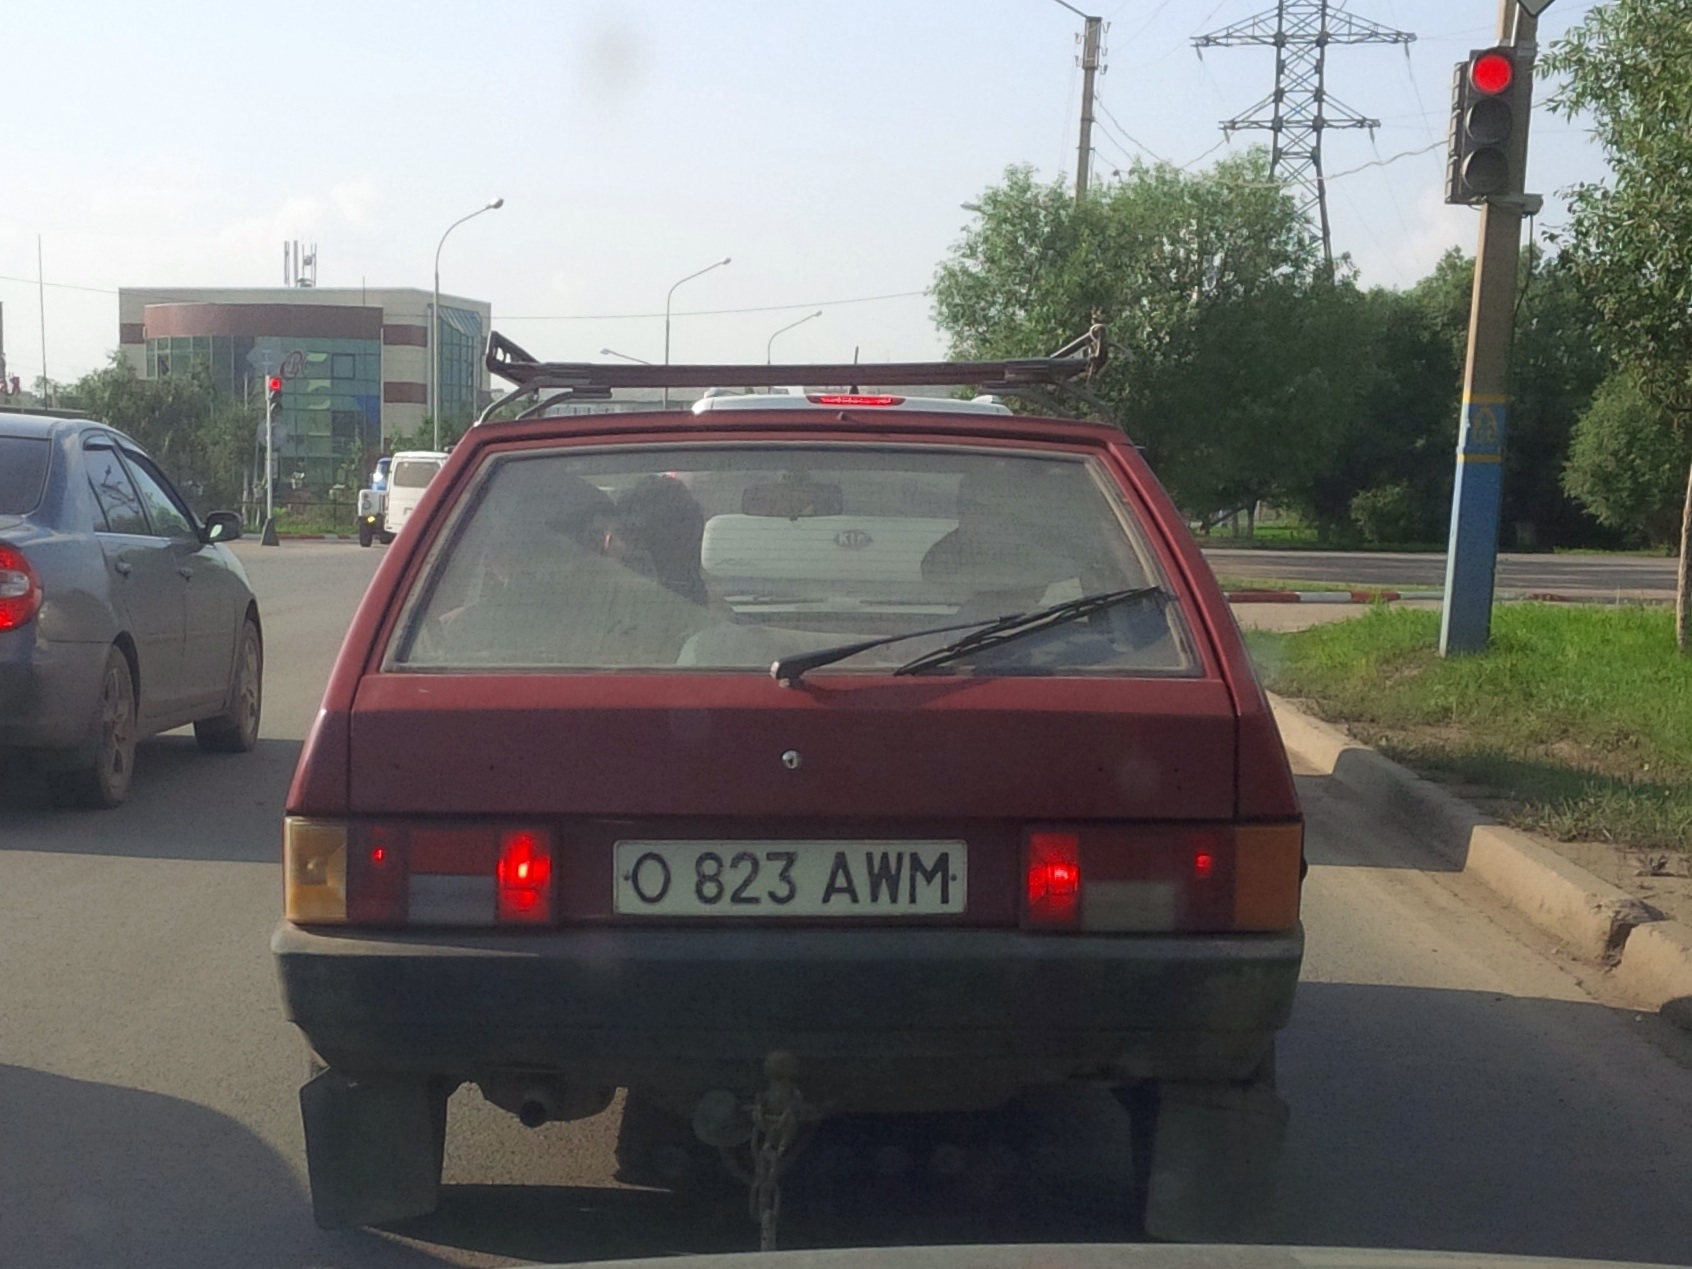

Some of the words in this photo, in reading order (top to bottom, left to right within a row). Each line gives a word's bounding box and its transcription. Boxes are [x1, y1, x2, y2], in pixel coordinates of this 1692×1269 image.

[631, 851, 671, 904] O
[694, 851, 798, 904] 823
[821, 851, 950, 904] AWM
